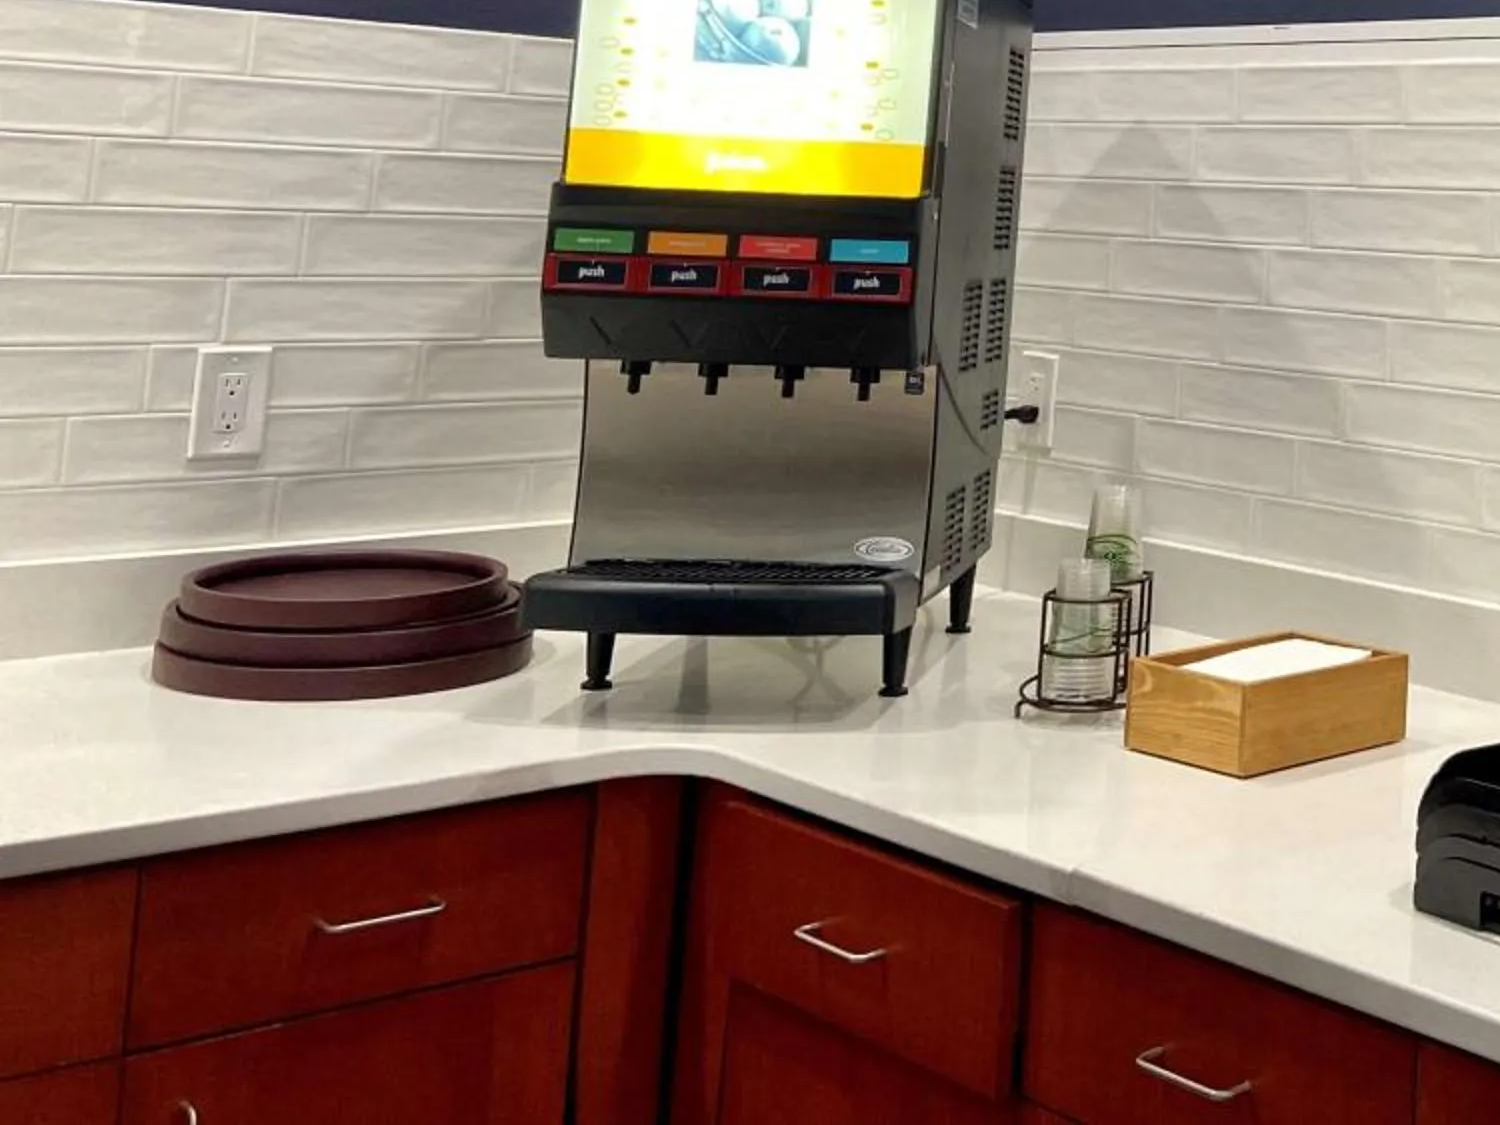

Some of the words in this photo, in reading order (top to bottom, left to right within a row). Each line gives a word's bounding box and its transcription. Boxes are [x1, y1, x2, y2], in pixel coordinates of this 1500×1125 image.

[579, 265, 605, 280] push
[671, 269, 697, 283] push
[763, 272, 790, 287] push
[853, 276, 880, 290] push
